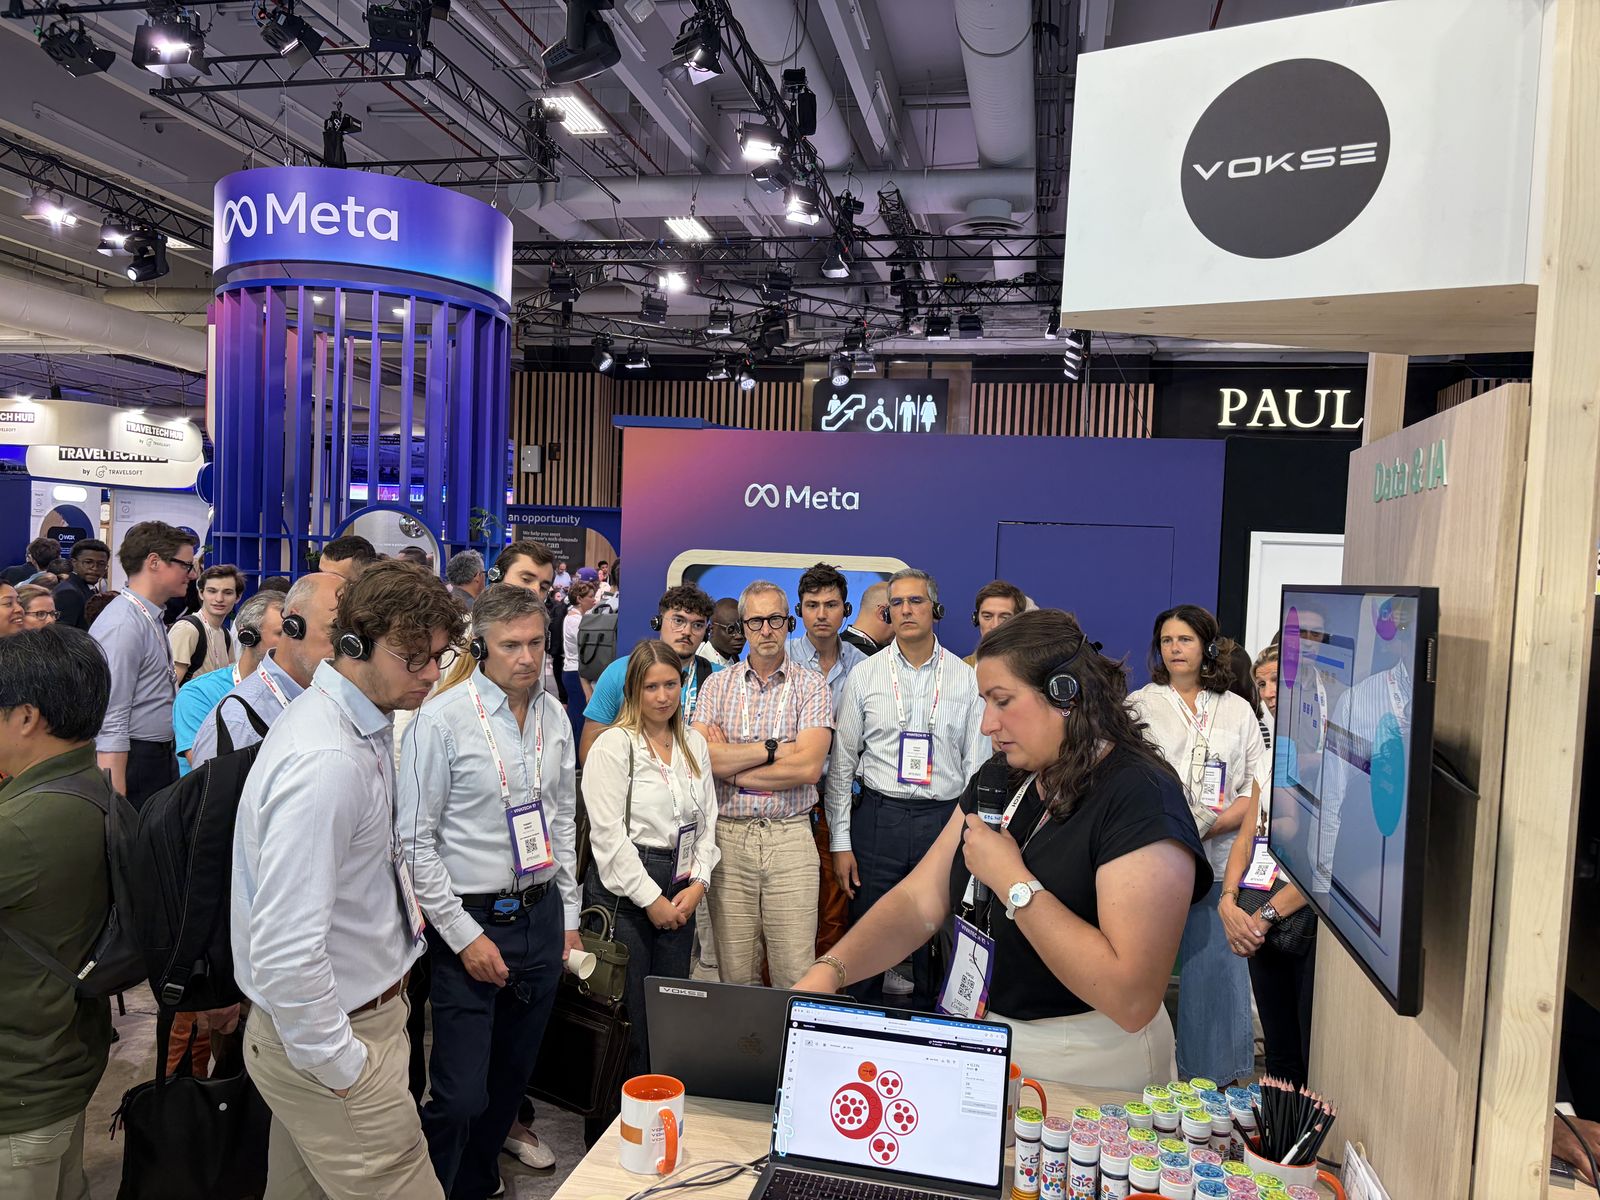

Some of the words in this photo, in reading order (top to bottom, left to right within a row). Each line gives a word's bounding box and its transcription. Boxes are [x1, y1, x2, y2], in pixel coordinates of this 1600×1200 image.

[1192, 142, 1378, 181] VOKSE
[266, 191, 399, 242] Meta
[14, 412, 34, 422] HUB
[1217, 388, 1364, 429] PAUL
[126, 421, 170, 438] TRAVELTECH
[60, 447, 140, 461] TRAVELTECH
[82, 468, 90, 476] by
[1375, 456, 1408, 503] Data
[1411, 447, 1424, 494] &
[1425, 438, 1448, 490] IA
[785, 485, 860, 511] Meta
[508, 513, 520, 522] an
[521, 513, 581, 526] opportunity
[663, 987, 705, 997] VOKSE
